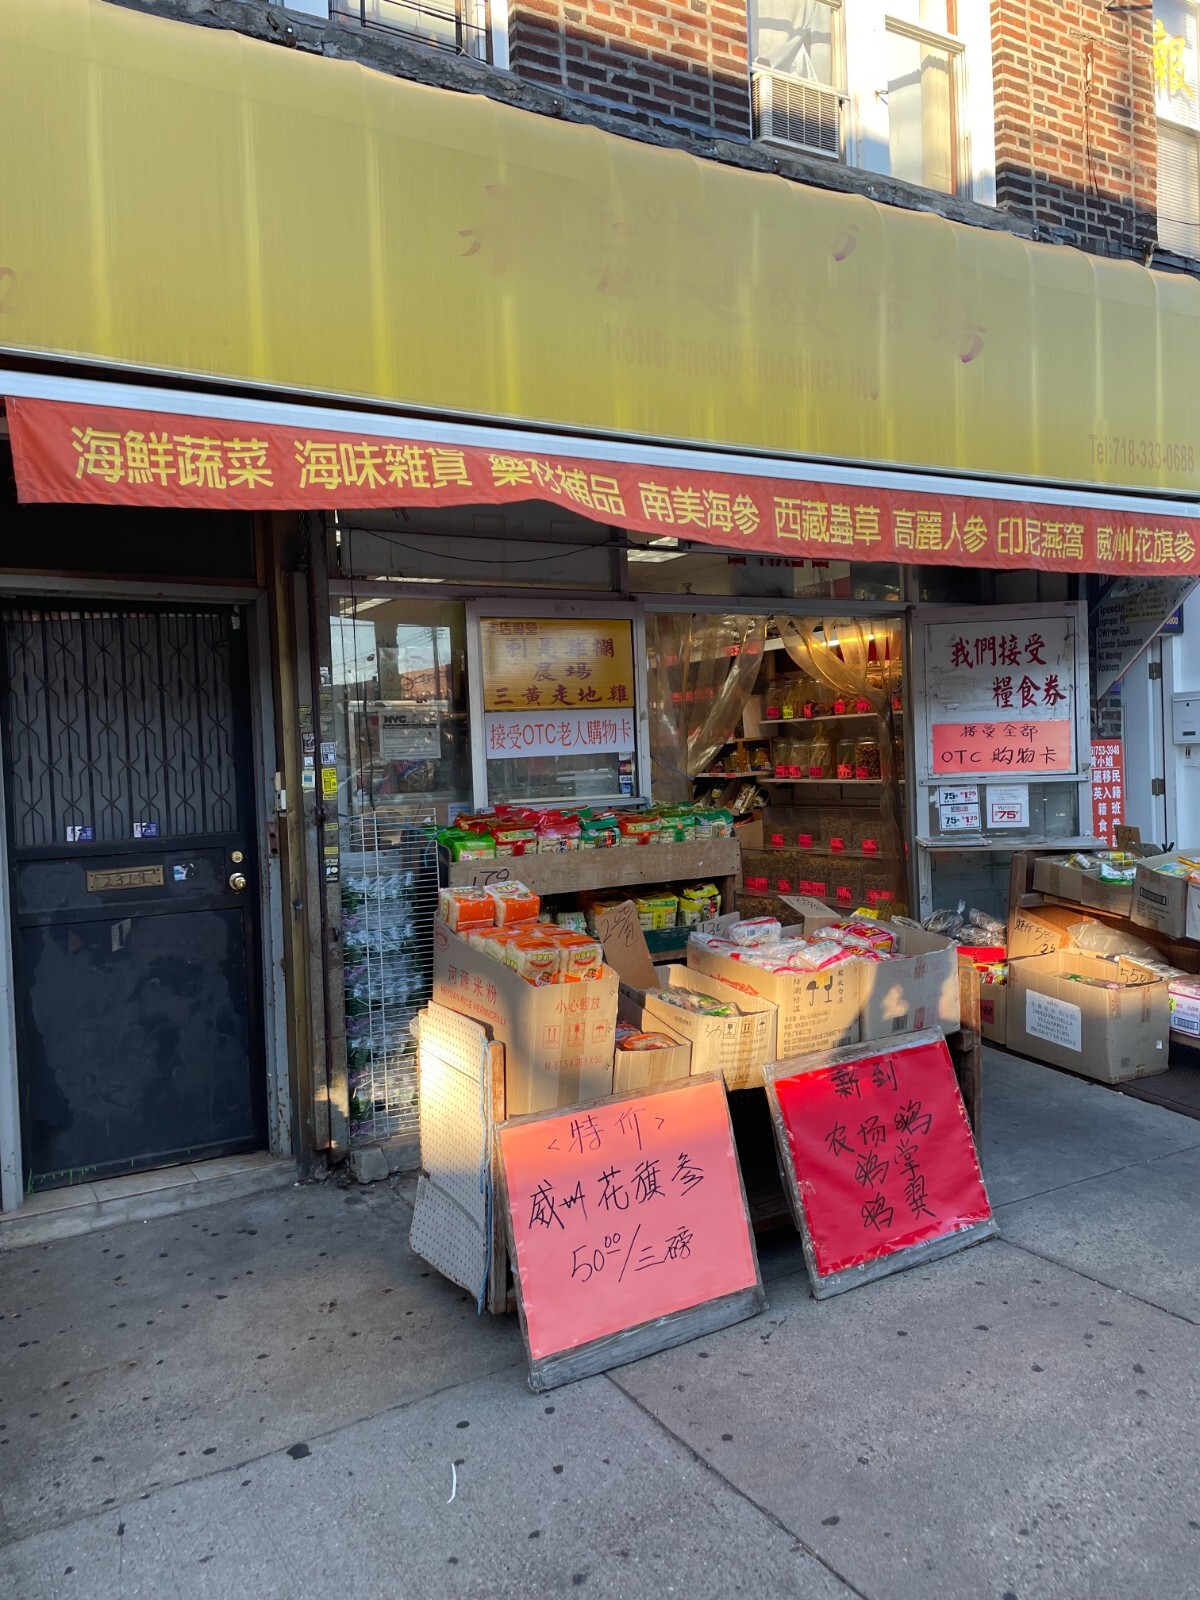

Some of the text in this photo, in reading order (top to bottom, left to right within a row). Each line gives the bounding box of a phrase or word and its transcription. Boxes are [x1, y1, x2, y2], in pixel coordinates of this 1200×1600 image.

[1088, 433, 1195, 474] Tel:718-333-0688
[70, 425, 275, 490] 海鮮蔬菜
[293, 439, 473, 490] 海味雜貨
[638, 480, 760, 535] 南美海參
[773, 496, 882, 547] 西藏蟲草
[892, 508, 988, 554] 高麗人參
[998, 516, 1084, 561] 印尼燕窩
[1097, 517, 1197, 564] 威州花旗參
[950, 632, 1047, 669] 我們接受
[1117, 639, 1143, 648] Suspension
[493, 683, 630, 706] 三黃走地雞
[384, 715, 406, 723] NYC
[489, 718, 632, 750] 接受OTC老人購物卡
[960, 724, 1039, 743] 接受全部
[448, 963, 498, 1005] 河源米粉
[831, 1060, 898, 1099] 新到
